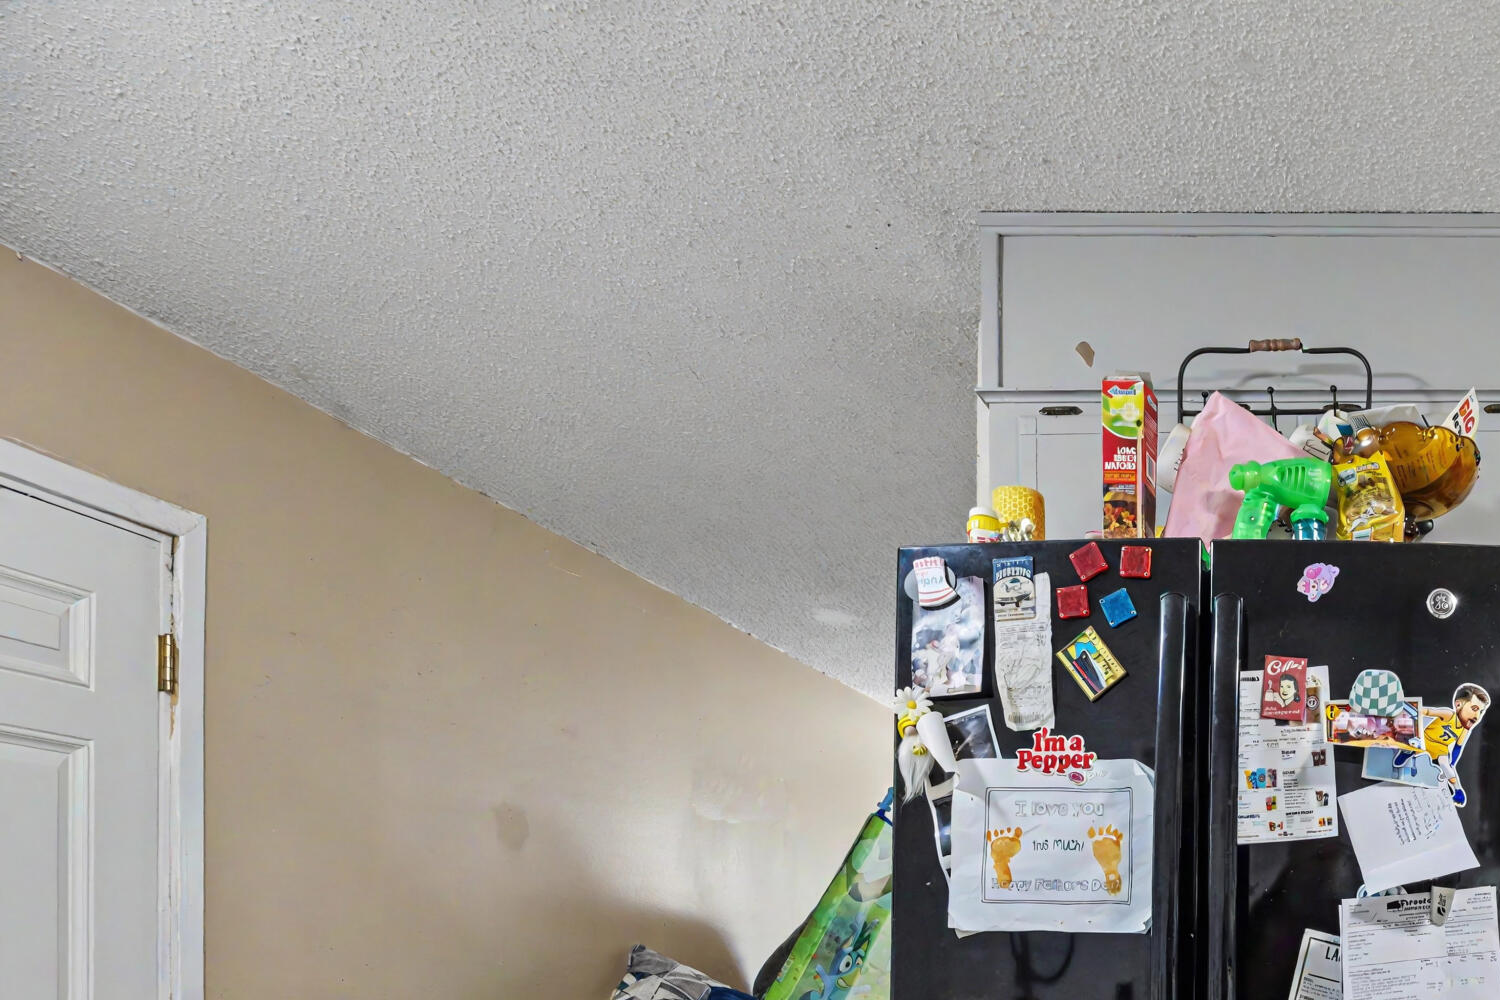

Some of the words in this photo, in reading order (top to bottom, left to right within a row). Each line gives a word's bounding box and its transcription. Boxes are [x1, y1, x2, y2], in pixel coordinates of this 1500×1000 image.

[1034, 727, 1065, 752] I'm
[1069, 737, 1083, 752] a
[1017, 750, 1095, 774] Pepper
[1014, 800, 1028, 817] I
[1325, 946, 1340, 962] LA
